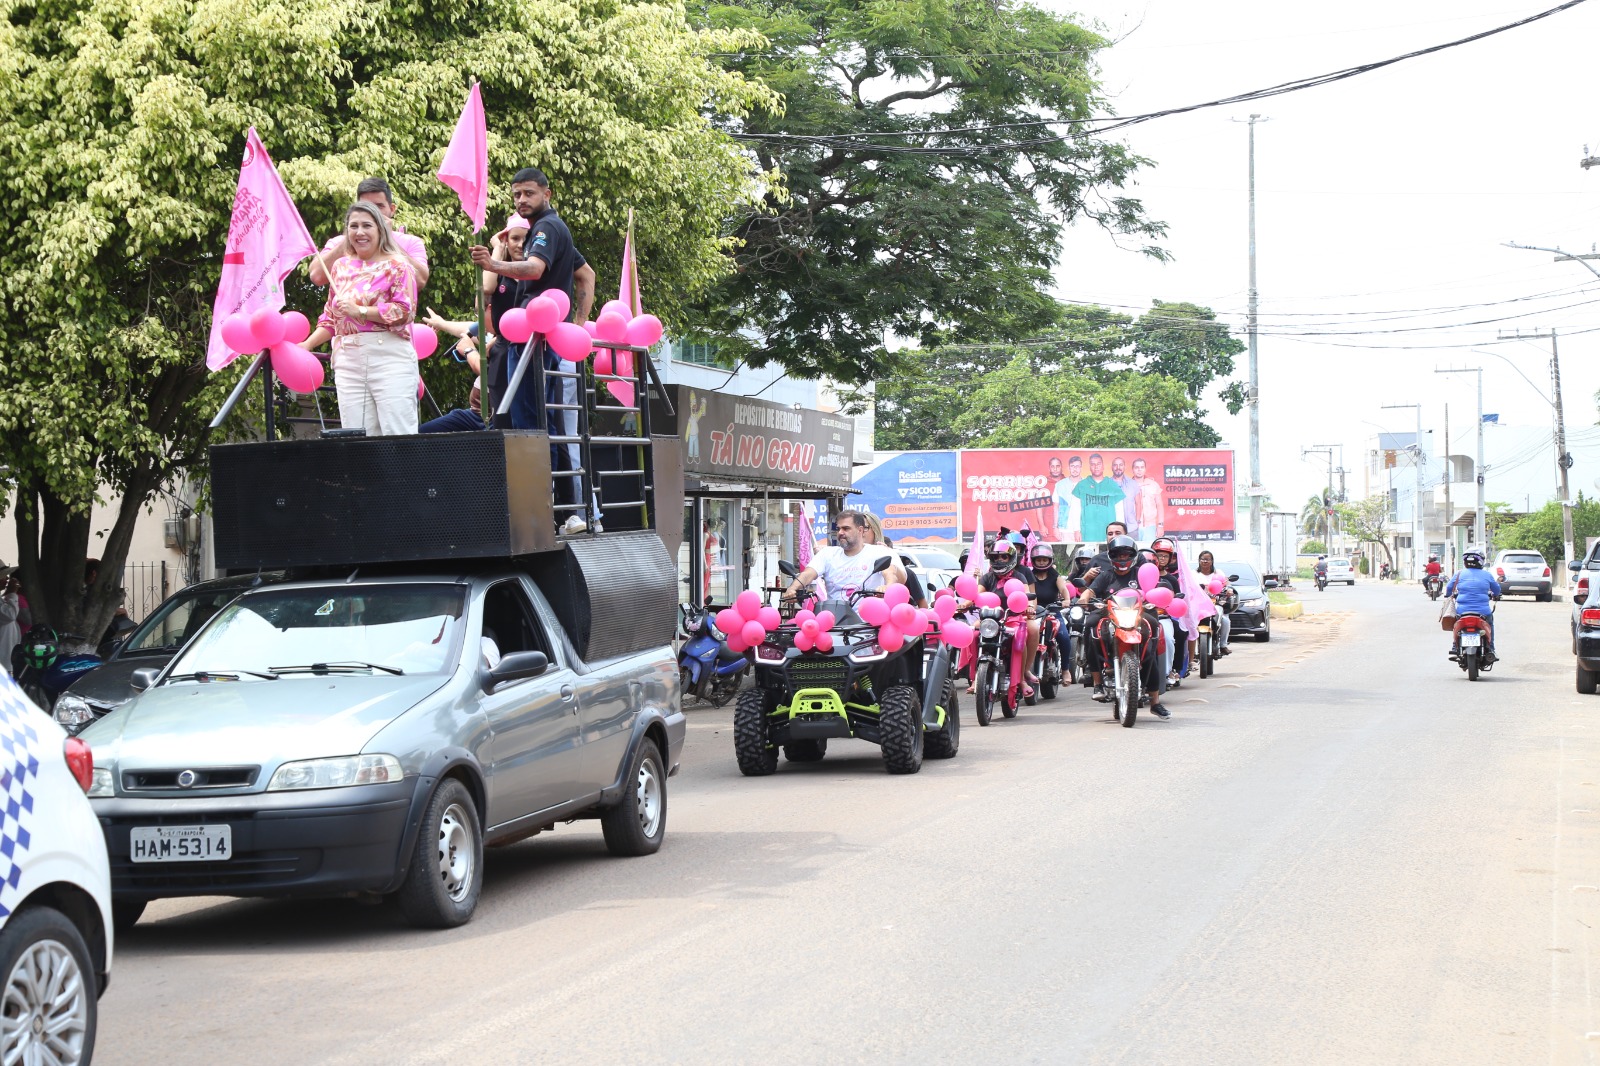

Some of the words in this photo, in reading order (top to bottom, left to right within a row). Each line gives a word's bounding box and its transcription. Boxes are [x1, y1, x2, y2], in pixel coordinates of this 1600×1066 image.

[231, 195, 262, 228] MAMA
[734, 403, 766, 428] DEPÓSITO
[766, 408, 775, 429] DE
[775, 410, 803, 434] BEBIDAS
[710, 422, 734, 466] TÁ
[735, 435, 766, 468] NO
[766, 437, 816, 475] GRAU
[898, 470, 942, 480] RealSolar
[1165, 466, 1225, 478] SÁB.02.12.23
[966, 475, 1048, 489] SORRISO
[909, 486, 943, 495] SICOOB
[971, 488, 1051, 502] MAROTO
[1013, 497, 1052, 511] ANTIGAS
[1170, 498, 1194, 506] VENDAS
[1186, 508, 1216, 517] ingresse
